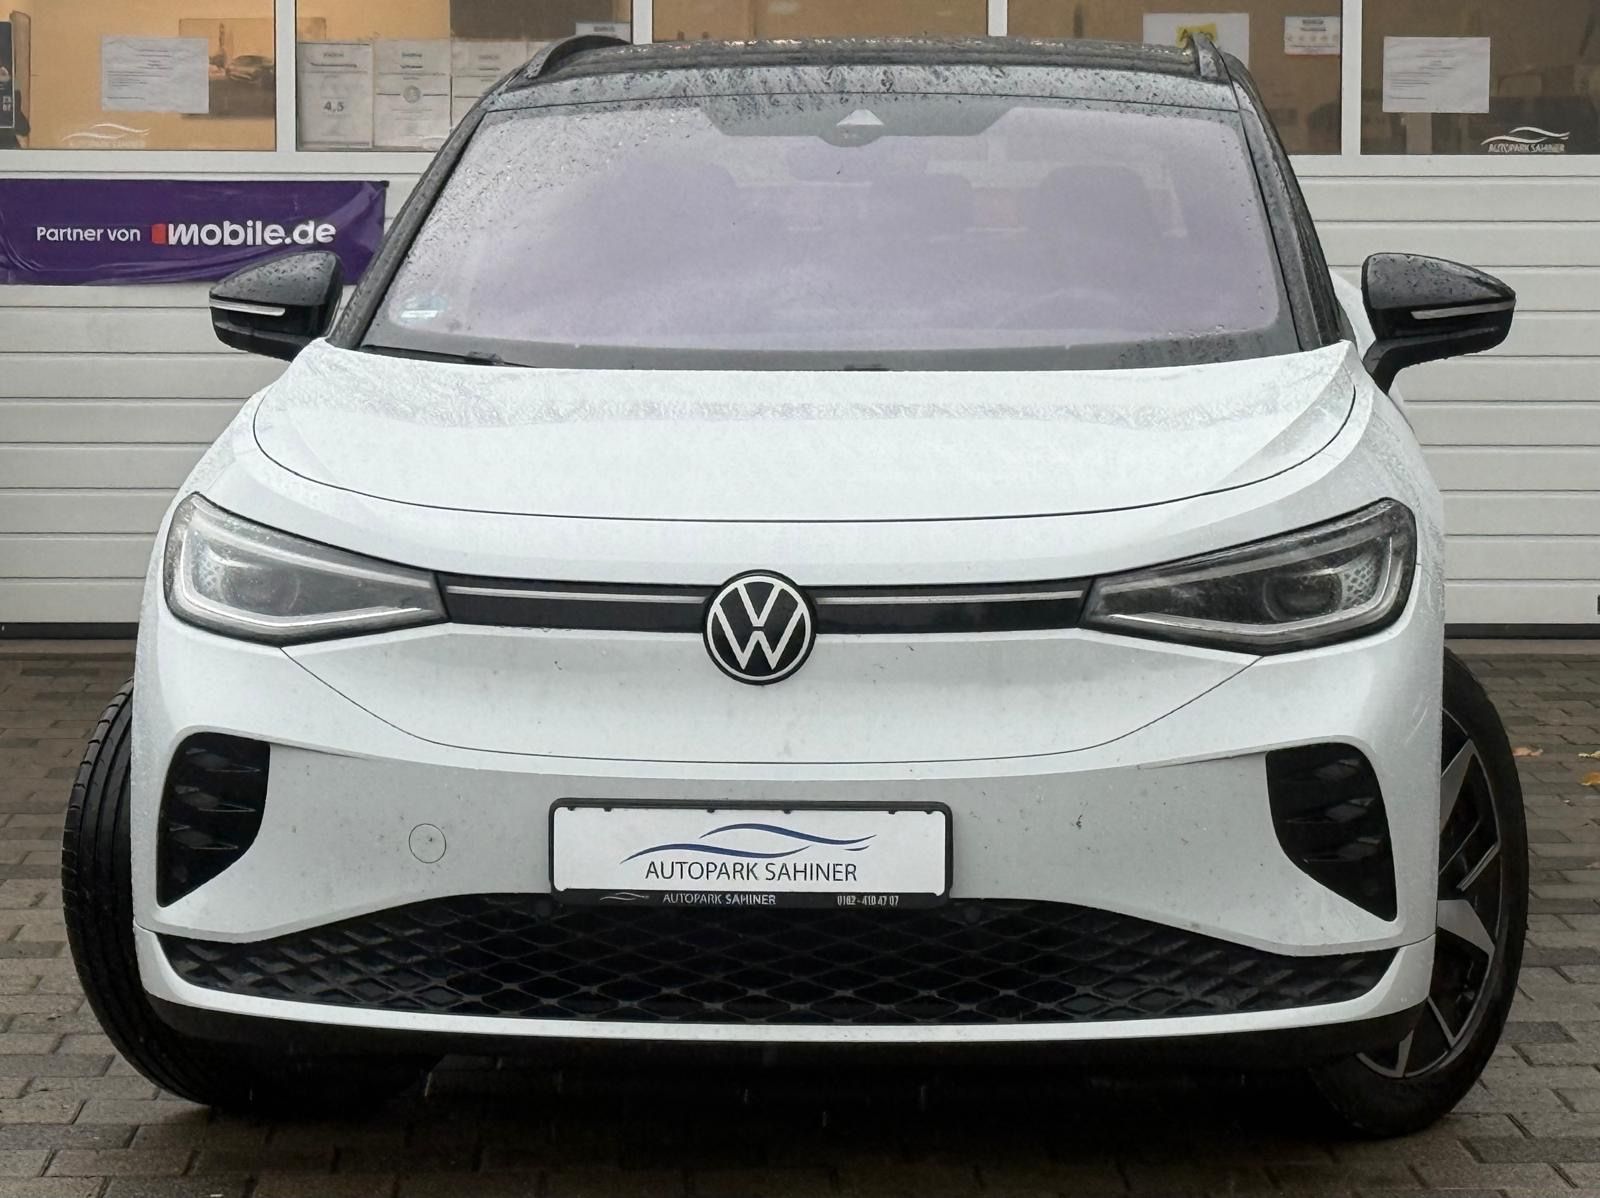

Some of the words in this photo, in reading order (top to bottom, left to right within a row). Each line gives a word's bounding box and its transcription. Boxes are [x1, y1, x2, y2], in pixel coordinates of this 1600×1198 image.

[36, 225, 103, 242] Partner
[107, 228, 141, 242] von
[168, 220, 337, 246] mobile.de
[645, 861, 759, 881] AUTOPARK
[765, 863, 858, 882] SAHINER
[662, 893, 722, 904] AUTOPARK
[725, 894, 776, 905] SAHINER
